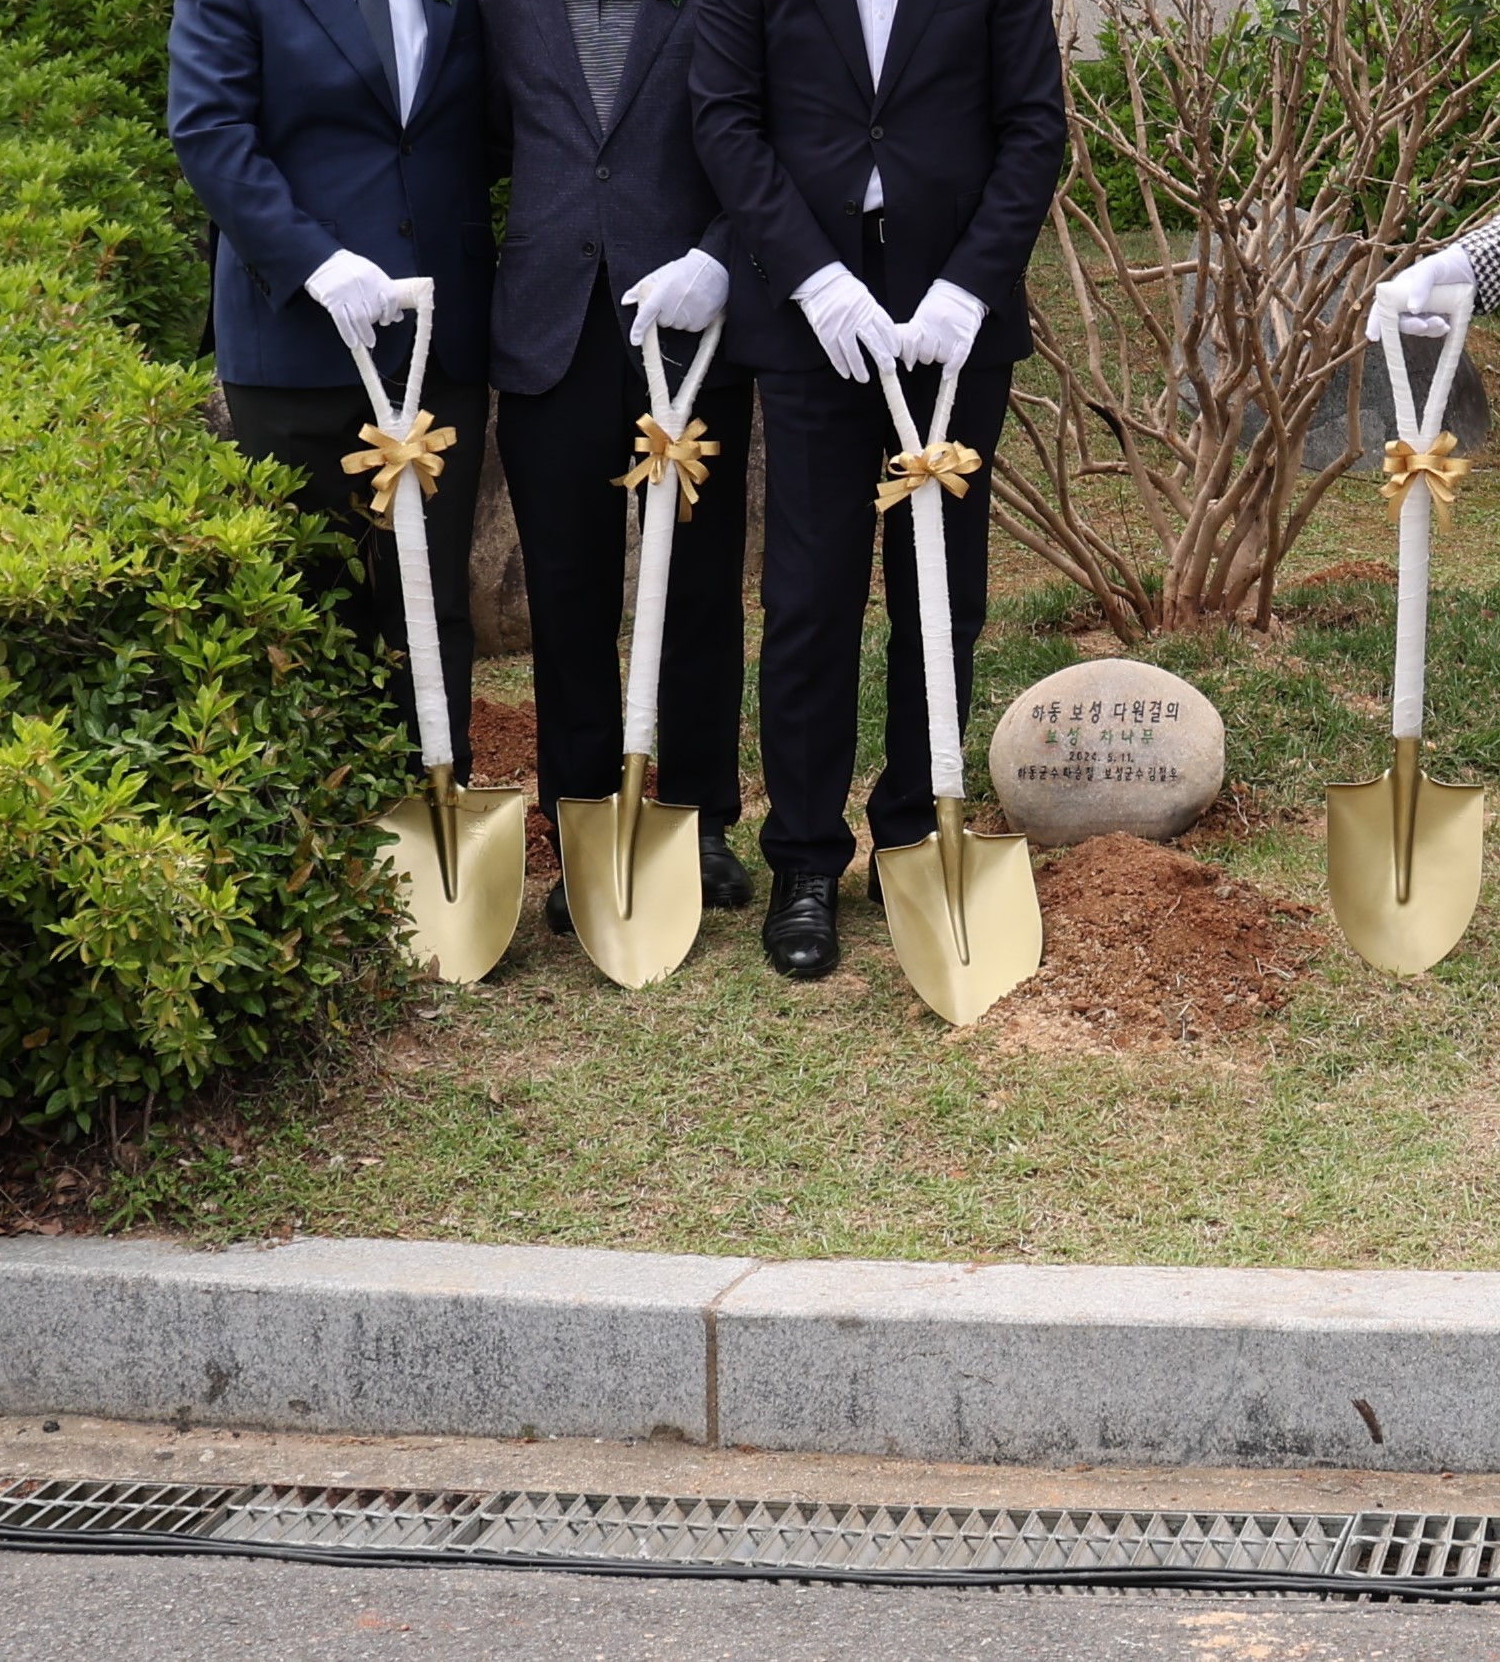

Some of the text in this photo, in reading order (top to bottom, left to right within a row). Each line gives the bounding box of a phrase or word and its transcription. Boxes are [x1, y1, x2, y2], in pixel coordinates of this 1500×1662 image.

[1032, 700, 1179, 723] 하동 보성 다원결의
[1045, 727, 1081, 746] 보성
